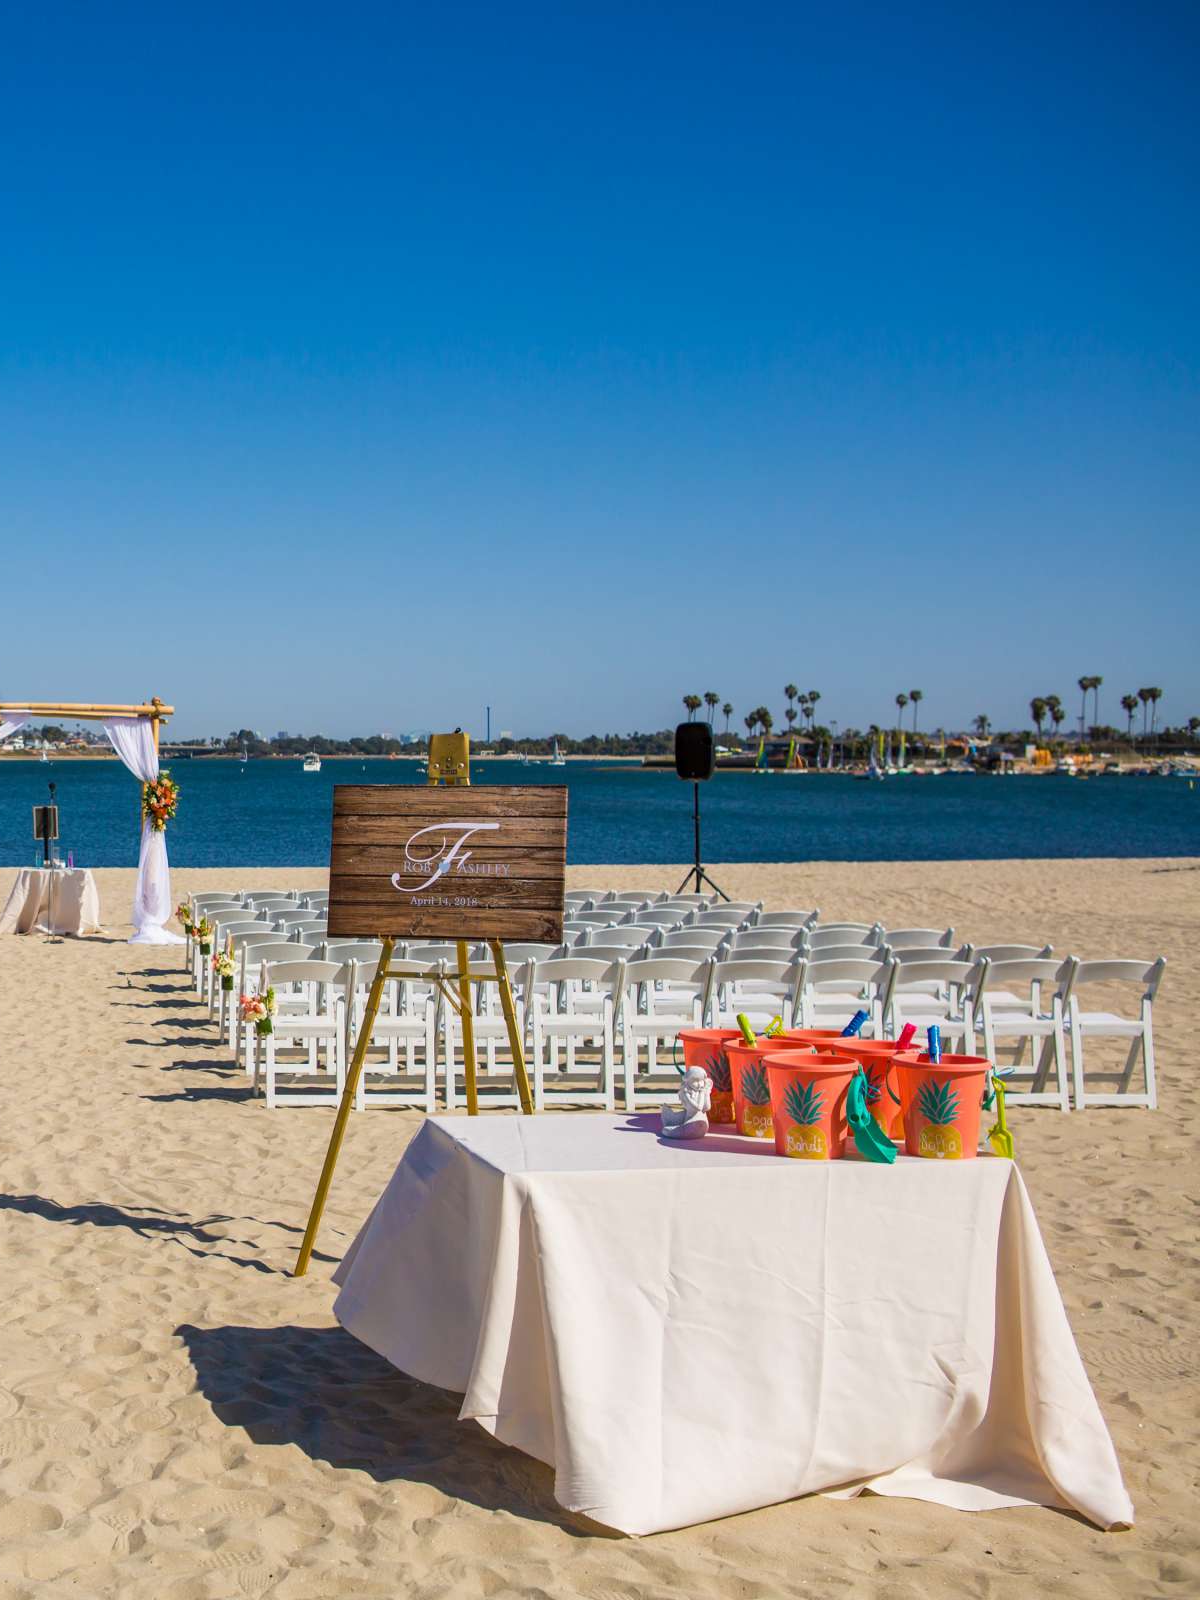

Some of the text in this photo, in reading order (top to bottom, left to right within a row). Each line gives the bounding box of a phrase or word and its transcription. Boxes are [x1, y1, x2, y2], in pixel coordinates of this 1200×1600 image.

[403, 861, 511, 876] ROB ASHLEY
[410, 895, 434, 907] April
[454, 897, 478, 907] 2018
[743, 1109, 775, 1131] Loga
